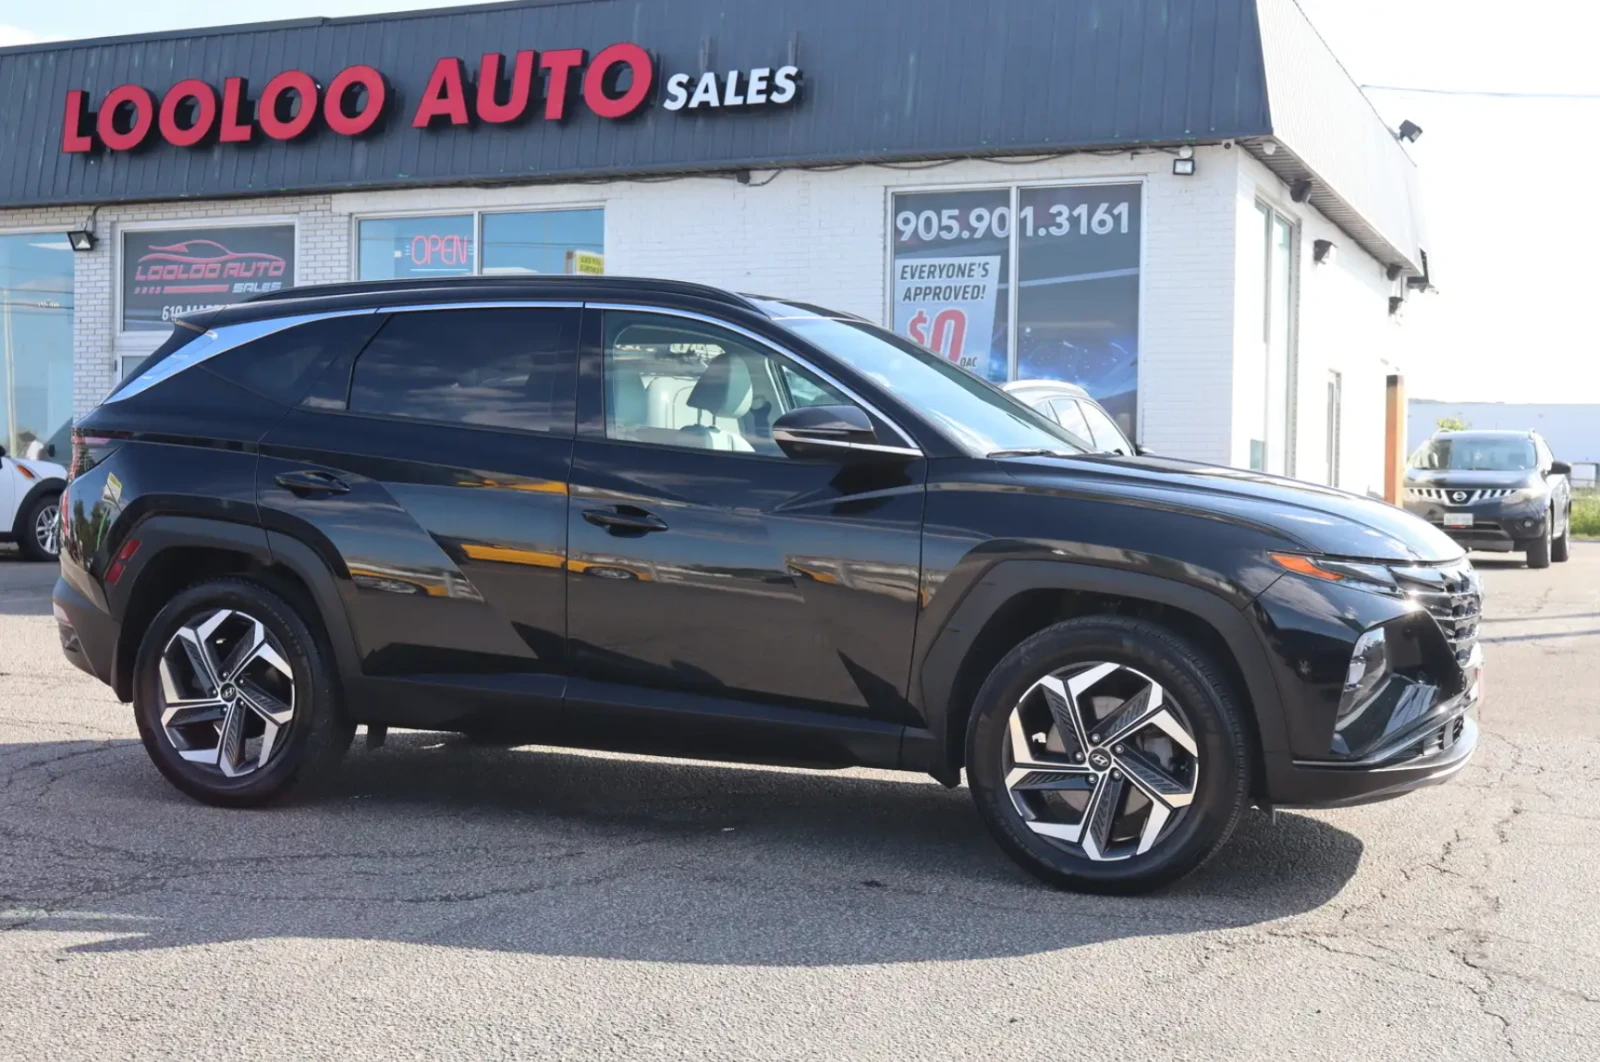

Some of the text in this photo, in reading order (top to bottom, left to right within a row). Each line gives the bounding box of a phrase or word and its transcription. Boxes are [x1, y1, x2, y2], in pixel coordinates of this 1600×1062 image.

[62, 42, 799, 153] LOOLOO AUTO SALES
[896, 202, 1130, 242] 905.901.3161
[411, 234, 469, 265] OPEN
[135, 260, 286, 281] LOOLOO AUTO
[900, 262, 990, 281] EVERYONE'S
[232, 281, 283, 294] SALES
[902, 284, 986, 302] APPROVED!
[909, 309, 967, 363] $0
[960, 357, 977, 367] OAC
